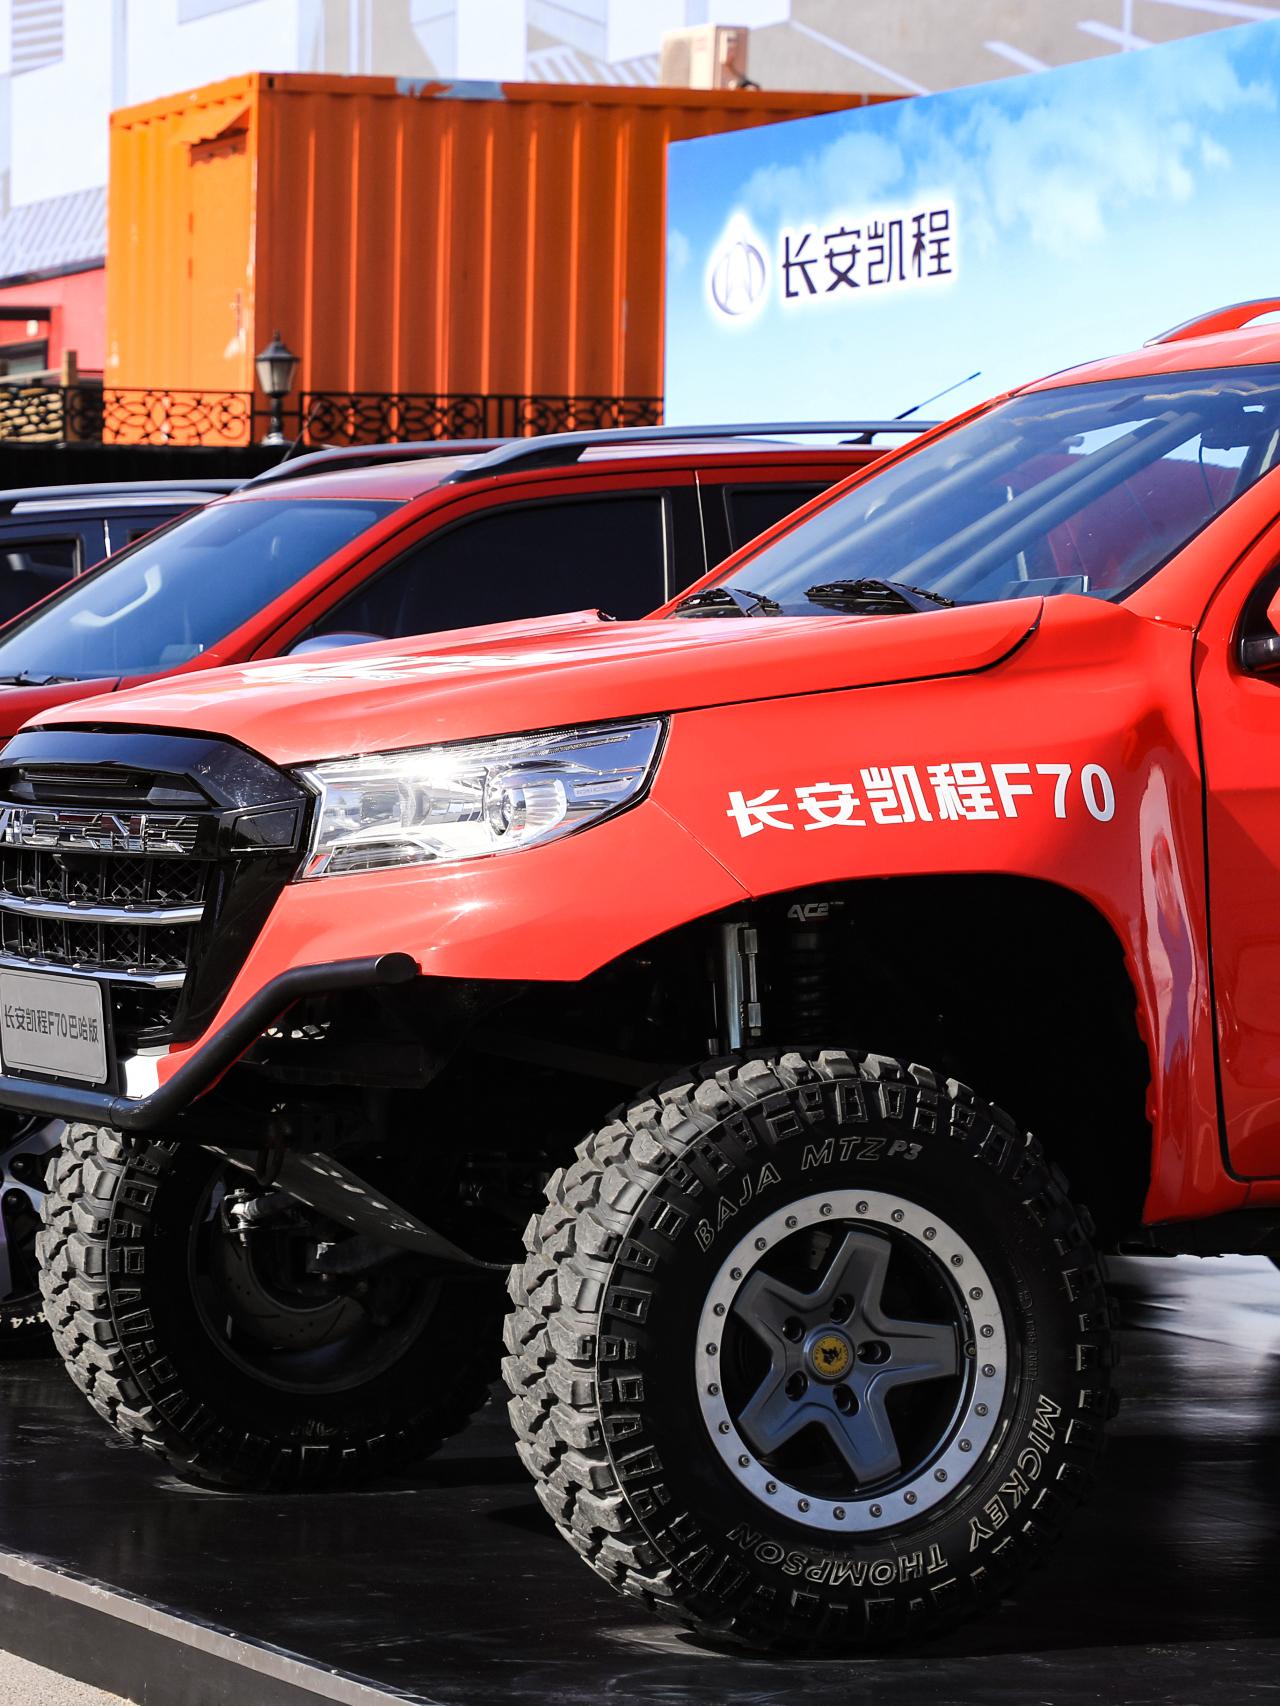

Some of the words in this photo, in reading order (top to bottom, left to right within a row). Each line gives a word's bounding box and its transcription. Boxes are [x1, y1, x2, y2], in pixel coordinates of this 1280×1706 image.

[782, 209, 952, 298] 长安凯程
[726, 762, 1116, 838] 长安凯程F70
[4, 1004, 99, 1043] 长安凯程F70巴哈版
[694, 1162, 782, 1252] BAJA
[801, 1137, 887, 1170] MTZ
[887, 1139, 924, 1161] P3
[969, 1394, 1062, 1553] MICKEY
[724, 1521, 949, 1587] THOMPSON
